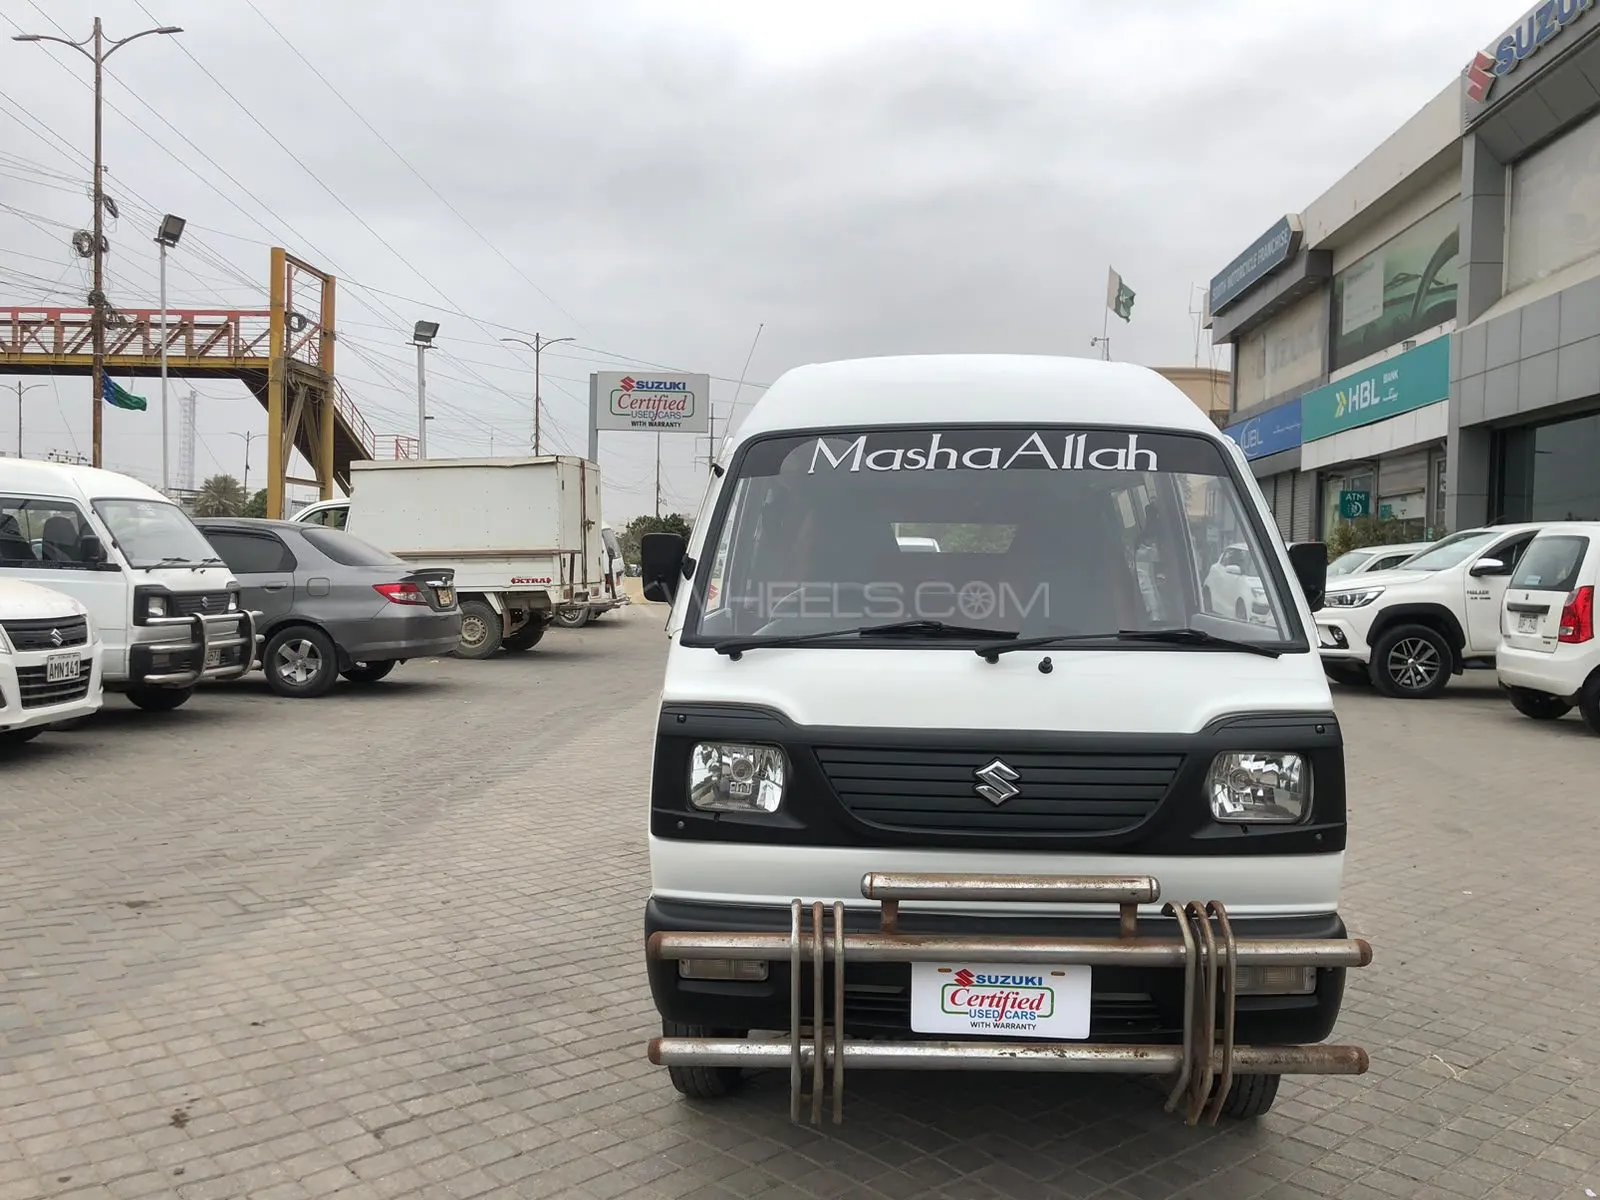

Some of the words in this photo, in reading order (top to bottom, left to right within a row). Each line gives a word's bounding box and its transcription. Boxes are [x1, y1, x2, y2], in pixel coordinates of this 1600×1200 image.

[1495, 0, 1593, 76] SUZU
[635, 380, 686, 390] SUZUKI
[1348, 378, 1381, 413] HBL
[617, 393, 688, 419] Certified
[631, 410, 655, 419] USED
[657, 411, 682, 420] CARS
[1243, 429, 1264, 449] UBL
[1345, 493, 1366, 501] ATM
[49, 660, 79, 679] AMN141
[975, 974, 1043, 986] SUZUKI
[950, 988, 1046, 1021] Certified
[968, 1009, 1000, 1019] USED
[1004, 1010, 1037, 1021] CARS
[970, 1021, 991, 1029] WITH
[992, 1022, 1037, 1031] WARRANTY
